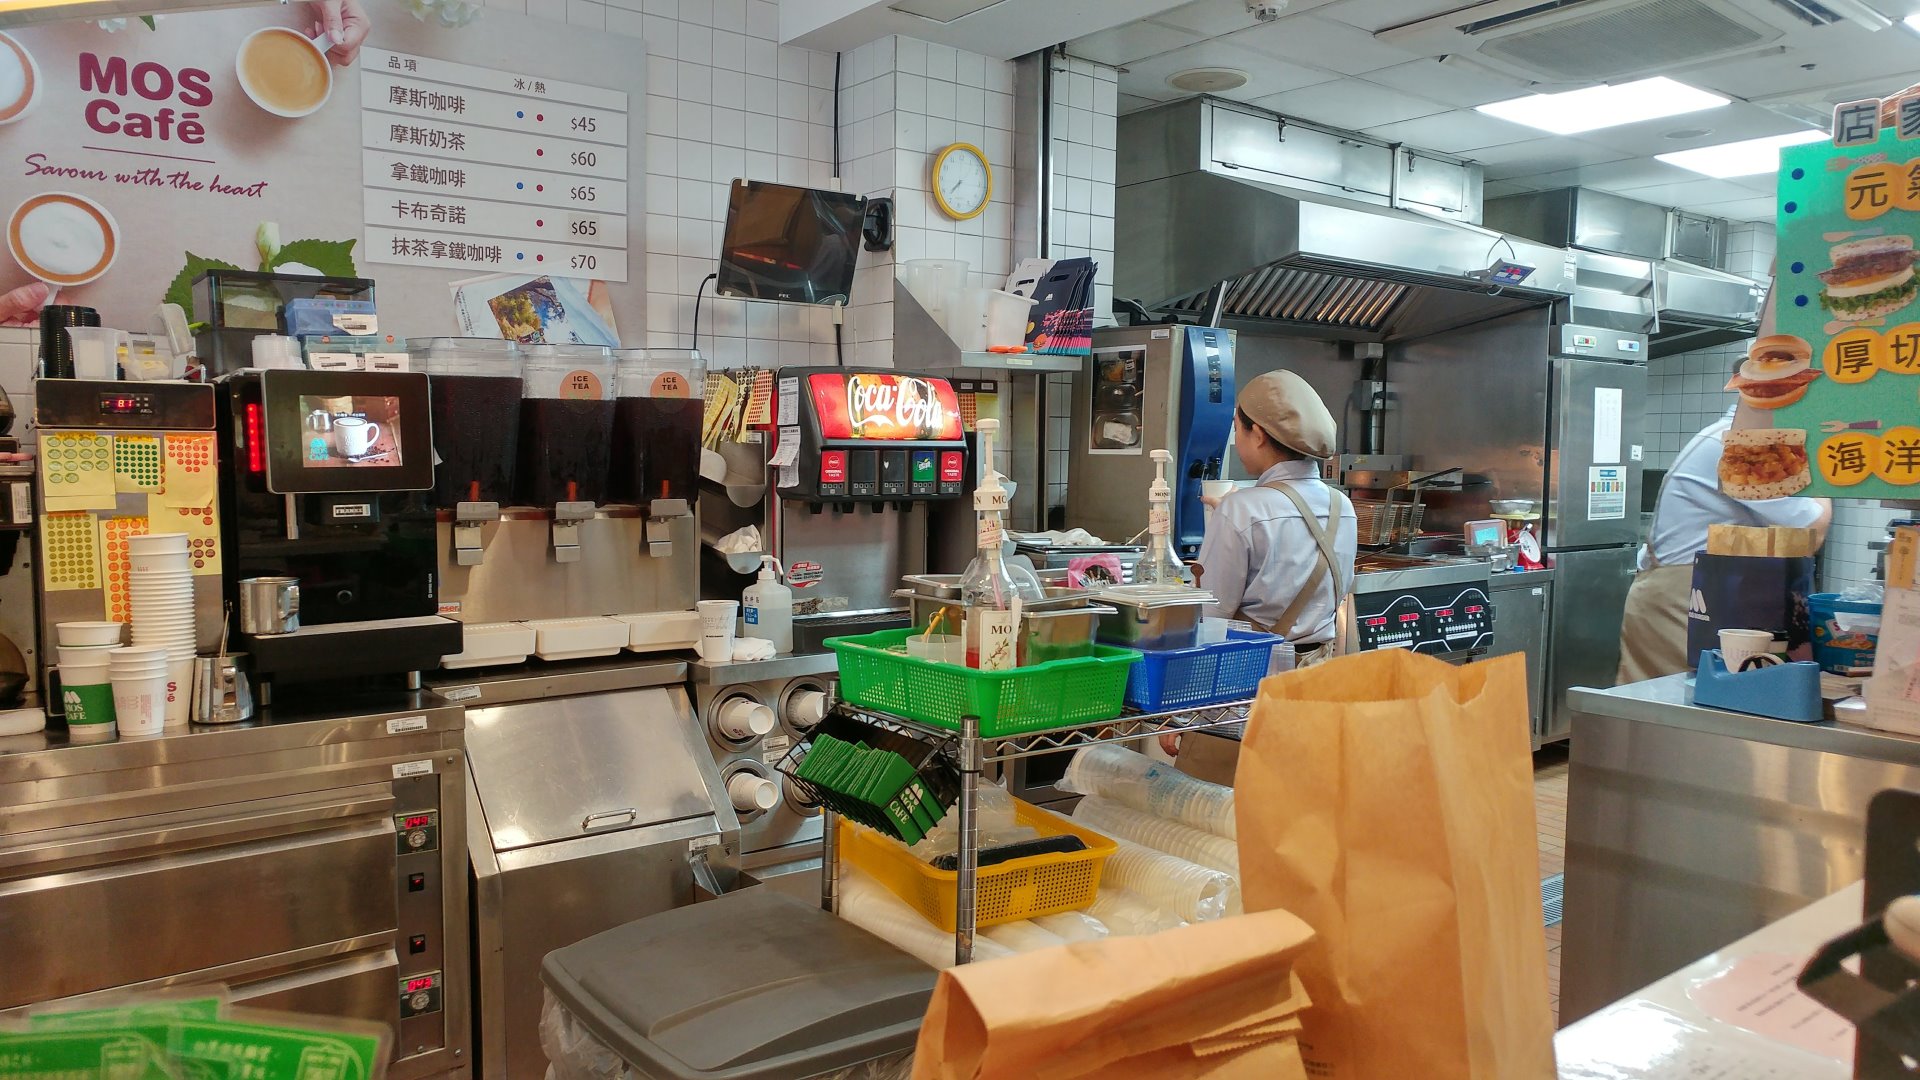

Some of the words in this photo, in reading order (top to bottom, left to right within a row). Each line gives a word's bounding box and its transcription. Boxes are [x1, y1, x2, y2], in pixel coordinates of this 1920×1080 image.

[388, 56, 418, 72] 品項
[79, 52, 213, 107] MOS
[389, 86, 466, 115] 摩斯咖啡
[571, 116, 597, 133] $45
[389, 124, 466, 152] 摩斯奶茶
[571, 151, 597, 168] $60
[24, 153, 107, 182] Savour
[114, 167, 164, 188] with
[166, 172, 204, 191] the
[209, 176, 268, 198] heart
[390, 162, 466, 188] 拿鐵咖啡
[570, 186, 596, 202] $65
[391, 199, 466, 225] 卡布奇諾
[571, 221, 597, 236] $65
[391, 236, 502, 264] 抹茶拿鐵咖啡
[571, 254, 597, 271] $70
[847, 375, 944, 429] Coca-Cola
[1826, 438, 1920, 477] 海洋
[889, 800, 910, 825] CAFE
